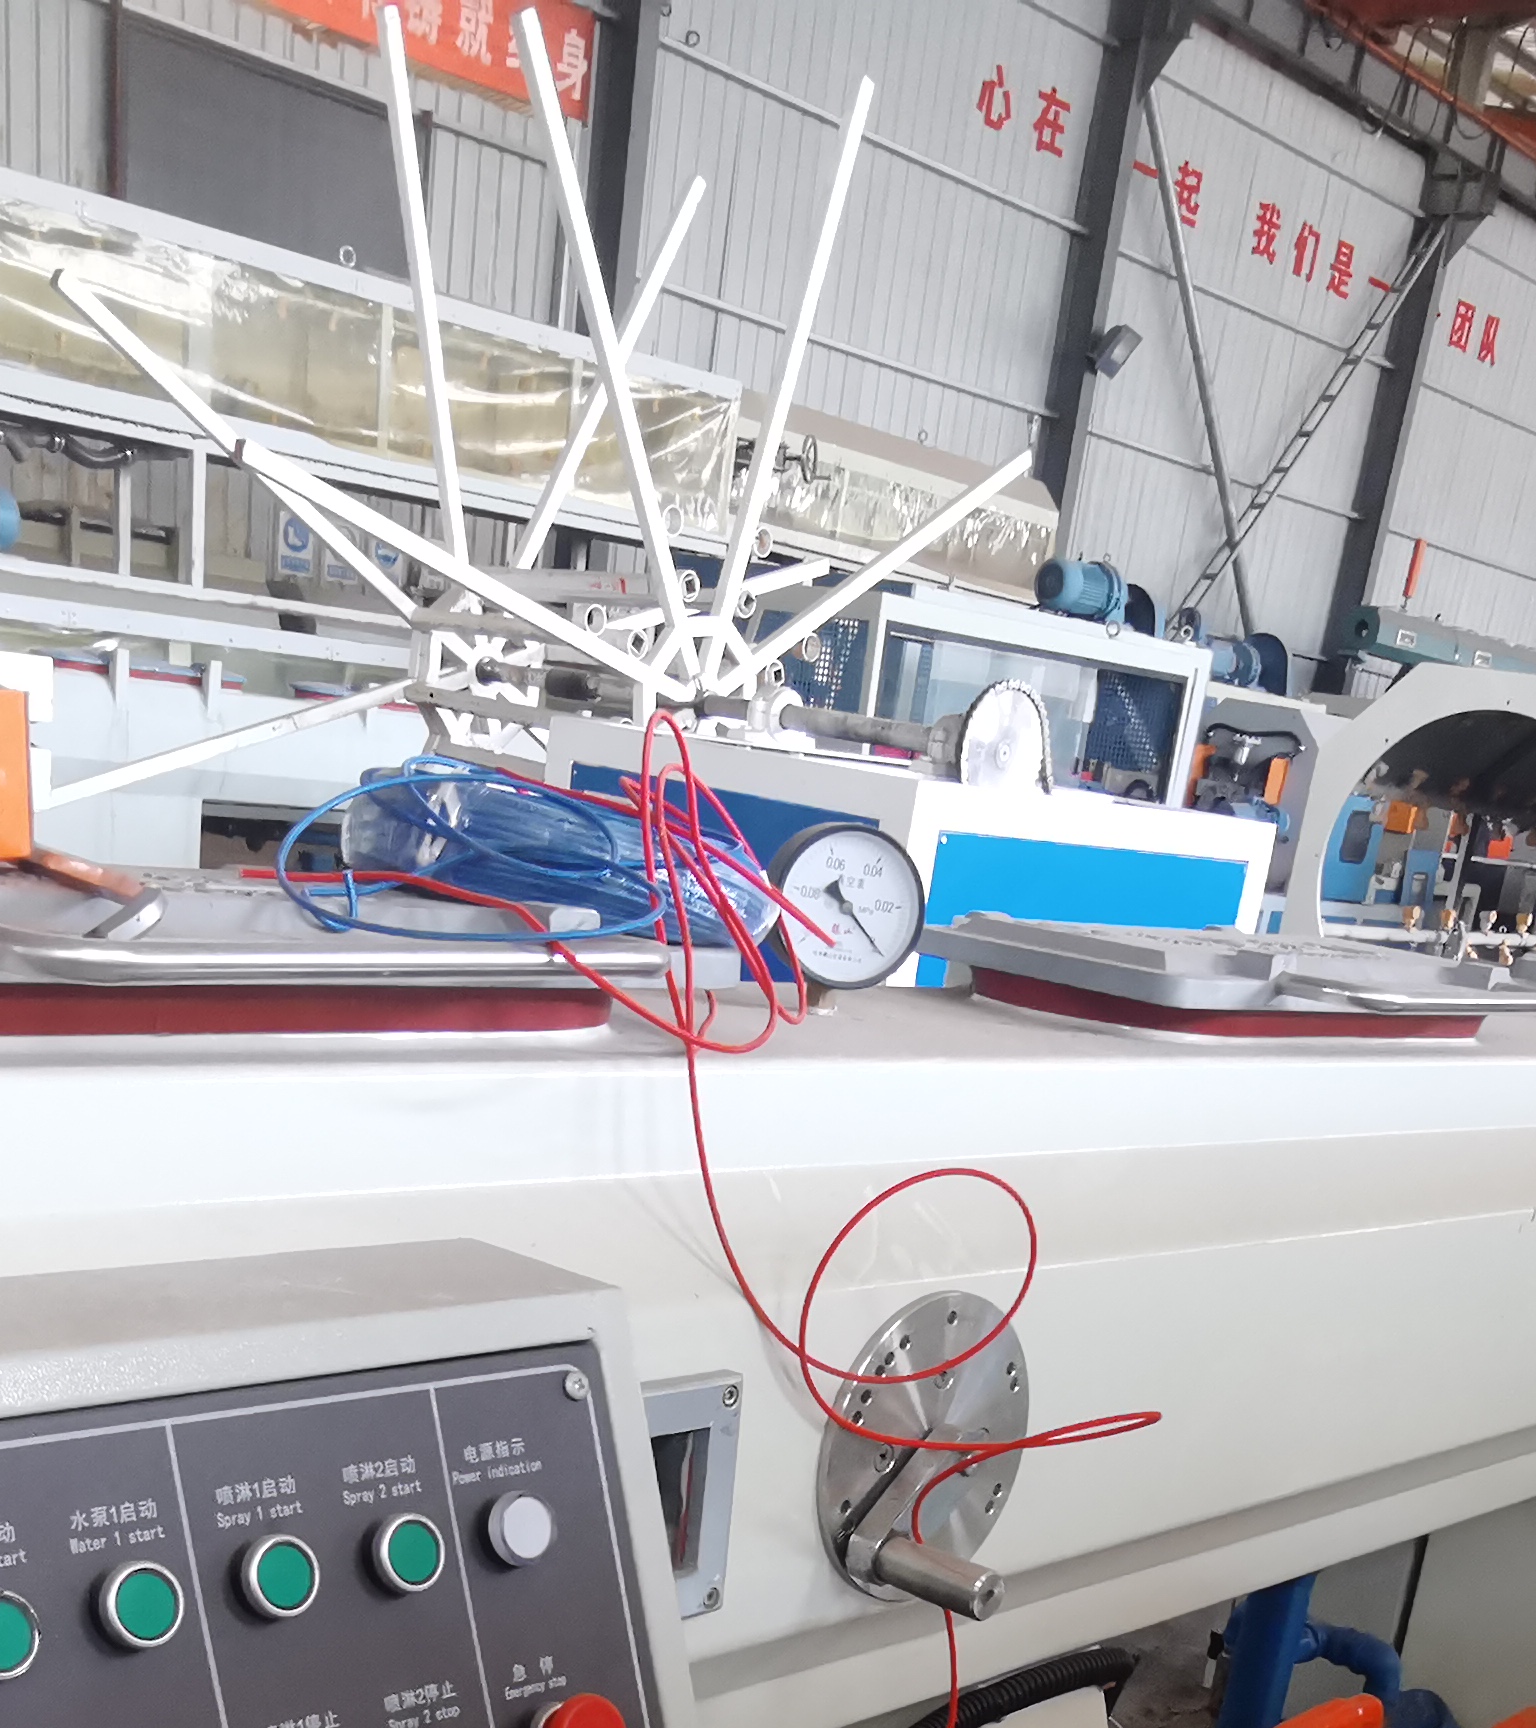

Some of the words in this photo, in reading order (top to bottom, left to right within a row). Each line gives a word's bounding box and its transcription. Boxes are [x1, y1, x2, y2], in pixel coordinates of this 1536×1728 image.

[863, 863, 883, 878] 0.04
[875, 899, 894, 914] 0.02
[341, 1454, 417, 1485] 喷淋2启动
[214, 1475, 298, 1506] 喷淋1启动
[342, 1487, 375, 1507] Spray
[379, 1484, 388, 1500] 2
[390, 1478, 423, 1497] start
[69, 1497, 159, 1533] 水泵1启动
[216, 1508, 253, 1530] Spray
[257, 1505, 264, 1521] 1
[269, 1500, 304, 1518] start
[68, 1534, 108, 1555] Water
[114, 1531, 121, 1547] 1
[127, 1524, 166, 1545] start
[383, 1680, 459, 1713] 喷淋2停止
[422, 1711, 431, 1725] 2
[435, 1704, 460, 1720] stop
